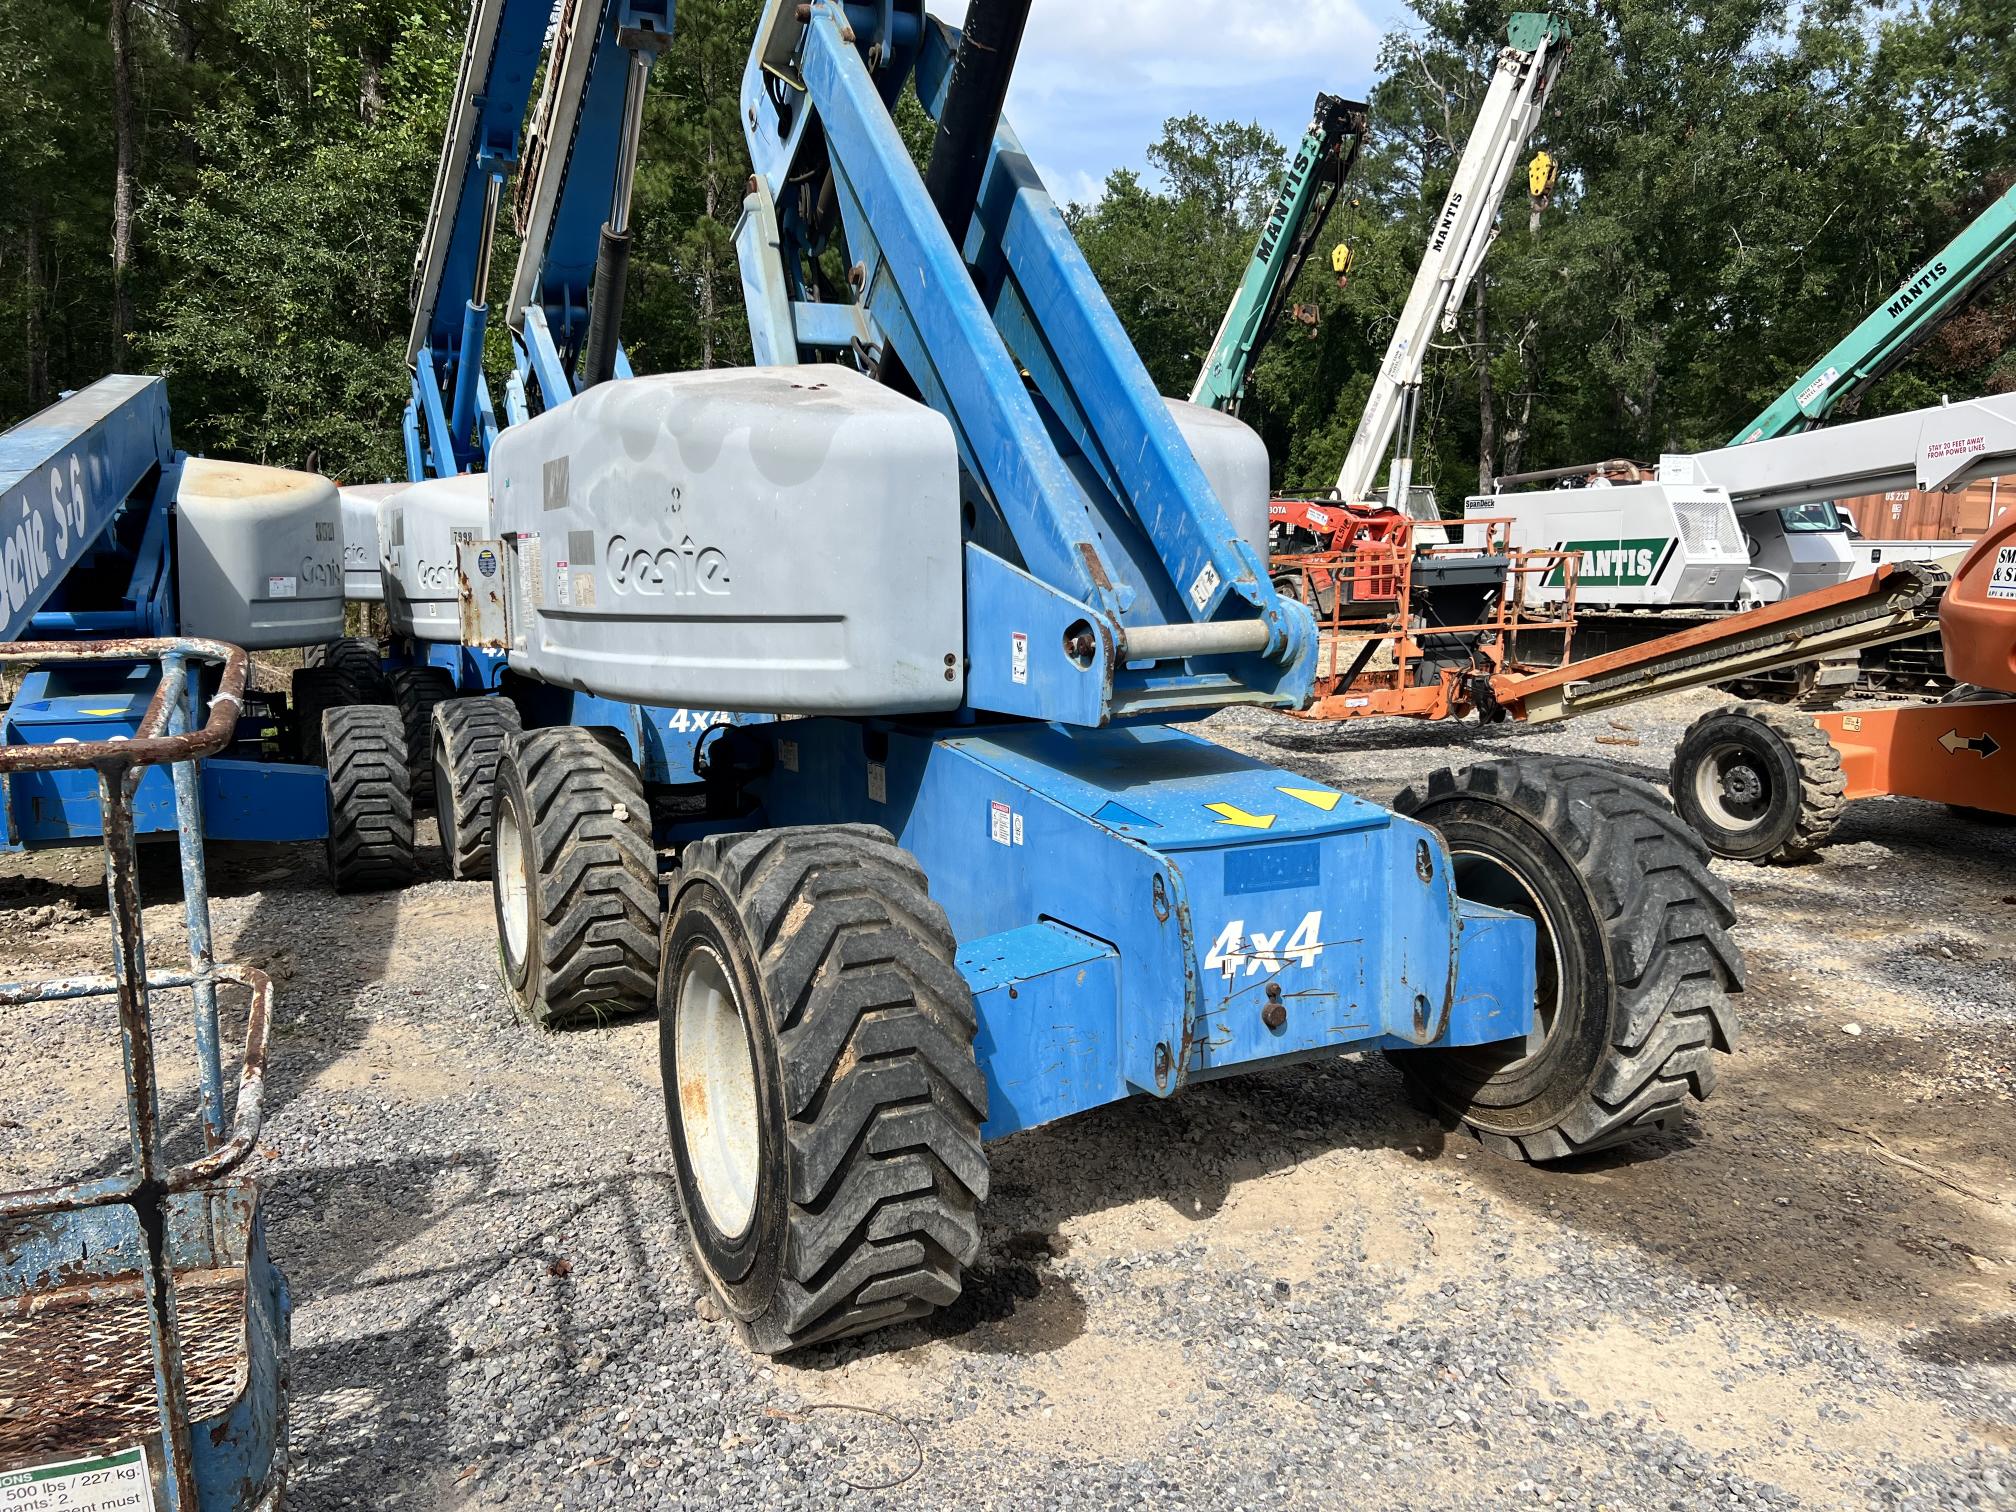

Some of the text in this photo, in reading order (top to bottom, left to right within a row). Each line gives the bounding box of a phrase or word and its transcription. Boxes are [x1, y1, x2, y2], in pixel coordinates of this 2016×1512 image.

[1257, 153, 1309, 265] MANTIS
[1432, 193, 1462, 253] MANTIS
[1887, 262, 1947, 319] MANTIS
[1927, 443, 1986, 459] FROM POWER LINES
[1928, 436, 1984, 452] STAY 20 FEET AWAY
[1465, 499, 1495, 509] SpanDeck
[606, 535, 731, 596] Genie
[1999, 549, 2016, 564] SM
[1204, 910, 1323, 980] 4x4
[6, 1467, 140, 1501] 500 lbs / 227 kg.
[102, 1493, 141, 1510] must
